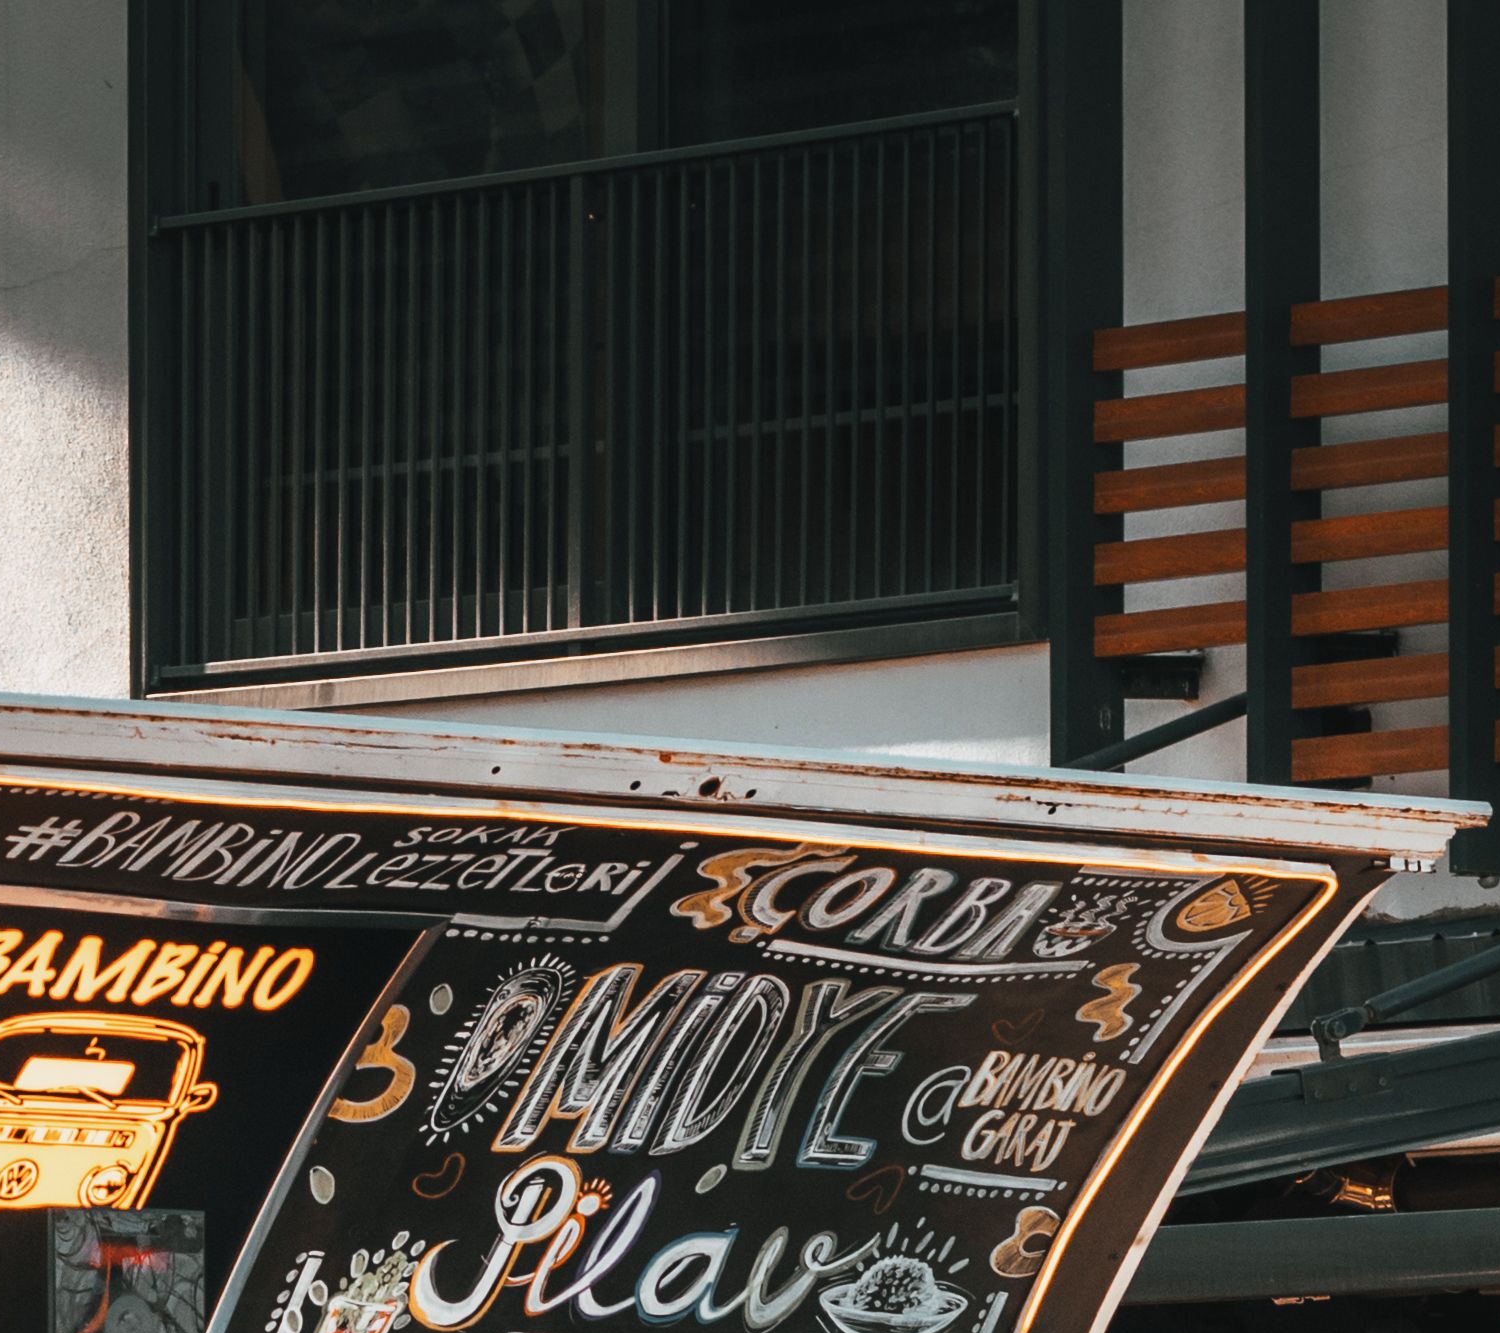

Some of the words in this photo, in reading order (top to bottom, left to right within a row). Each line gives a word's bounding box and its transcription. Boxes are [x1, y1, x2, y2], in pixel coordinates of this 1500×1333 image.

[393, 825, 579, 848] SOKAK
[961, 1109, 1076, 1171] GARAJ
[410, 1155, 882, 1331] Pilav
